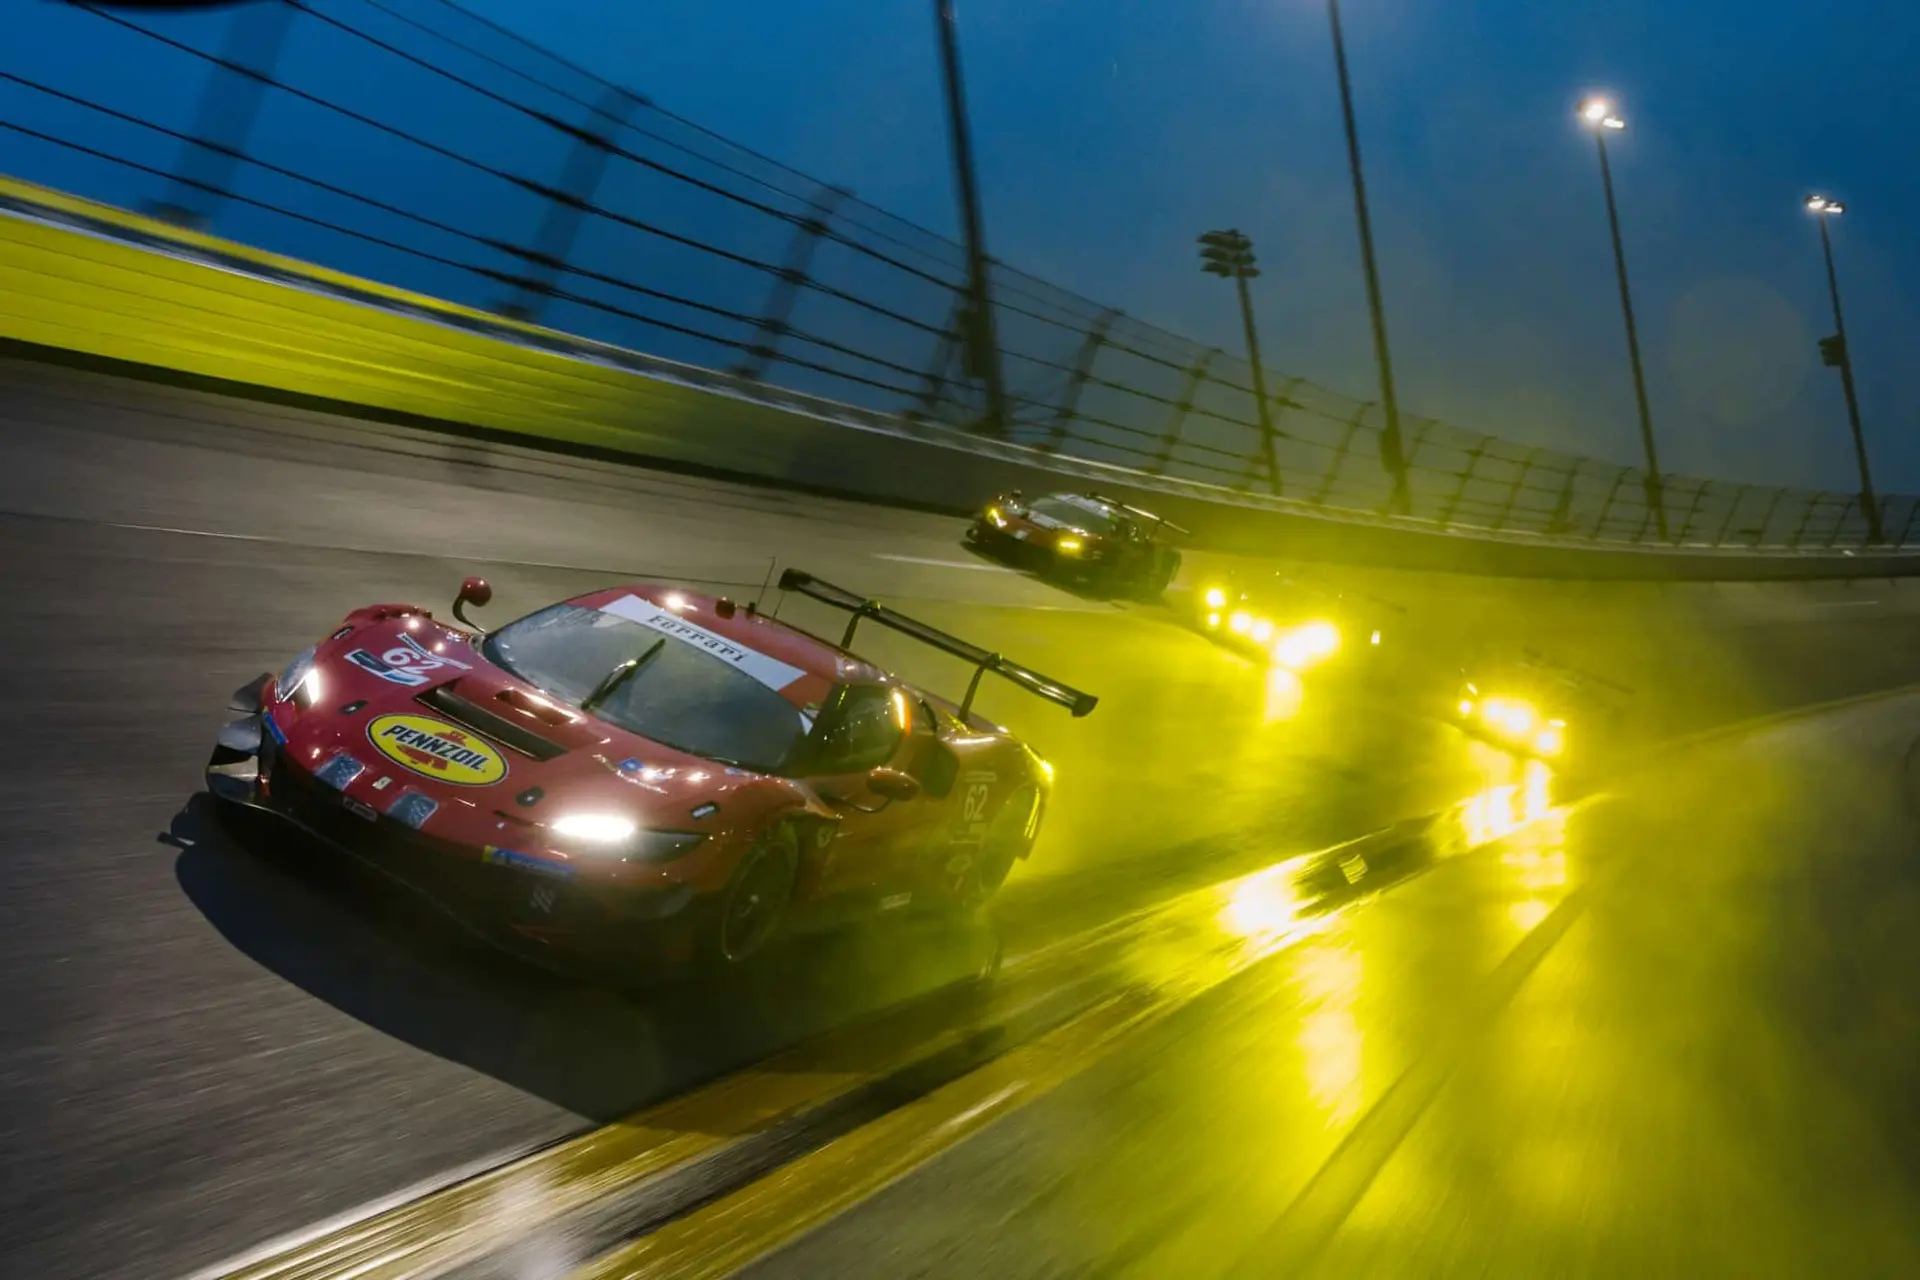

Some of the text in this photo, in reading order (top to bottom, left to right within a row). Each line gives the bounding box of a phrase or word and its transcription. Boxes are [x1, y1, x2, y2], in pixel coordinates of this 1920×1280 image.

[382, 647, 444, 674] 62
[648, 615, 748, 662] Ferrari
[381, 724, 489, 771] PENNZOIL
